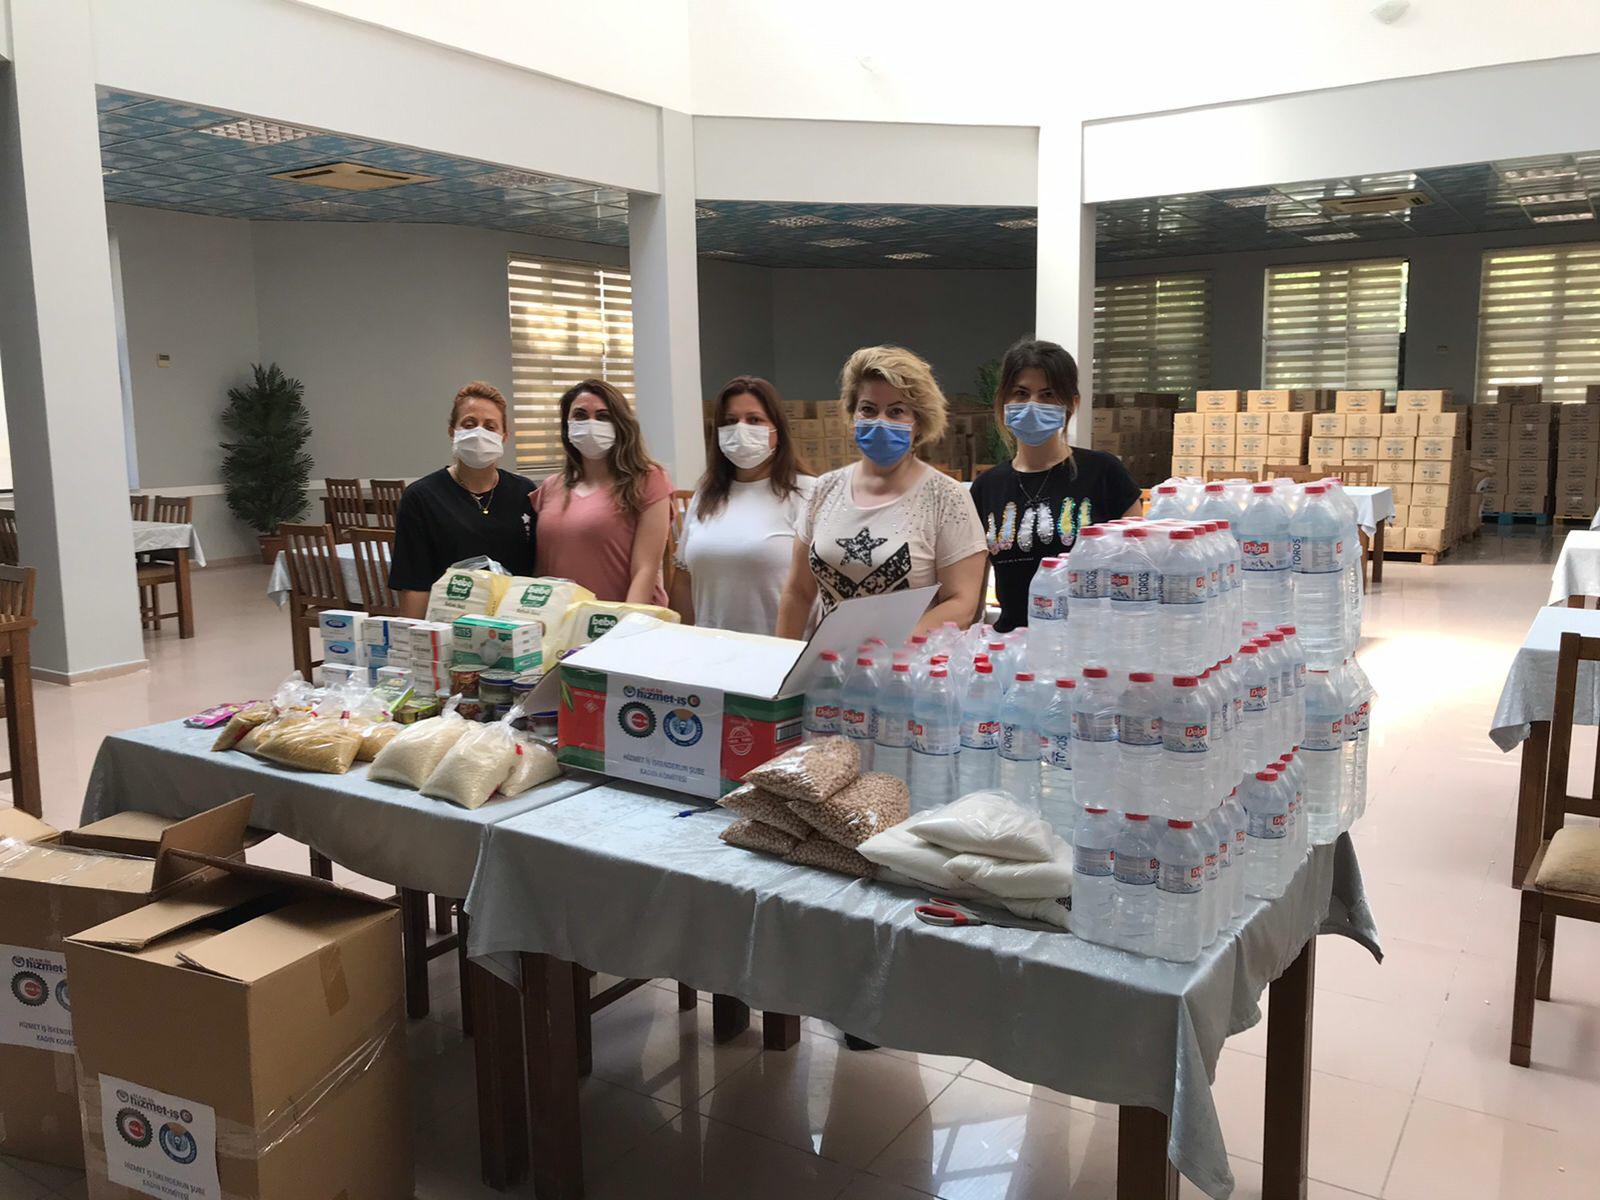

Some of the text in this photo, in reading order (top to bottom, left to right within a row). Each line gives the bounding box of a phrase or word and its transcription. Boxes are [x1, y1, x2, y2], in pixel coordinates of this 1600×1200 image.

[1243, 541, 1268, 554] Dolga
[1292, 538, 1301, 565] TOROS
[451, 576, 472, 588] bebe
[1086, 569, 1098, 593] TOROS
[1138, 572, 1149, 595] TOROS
[526, 585, 552, 596] bebe
[592, 615, 617, 627] bebe
[26, 958, 66, 974] hizmet-
